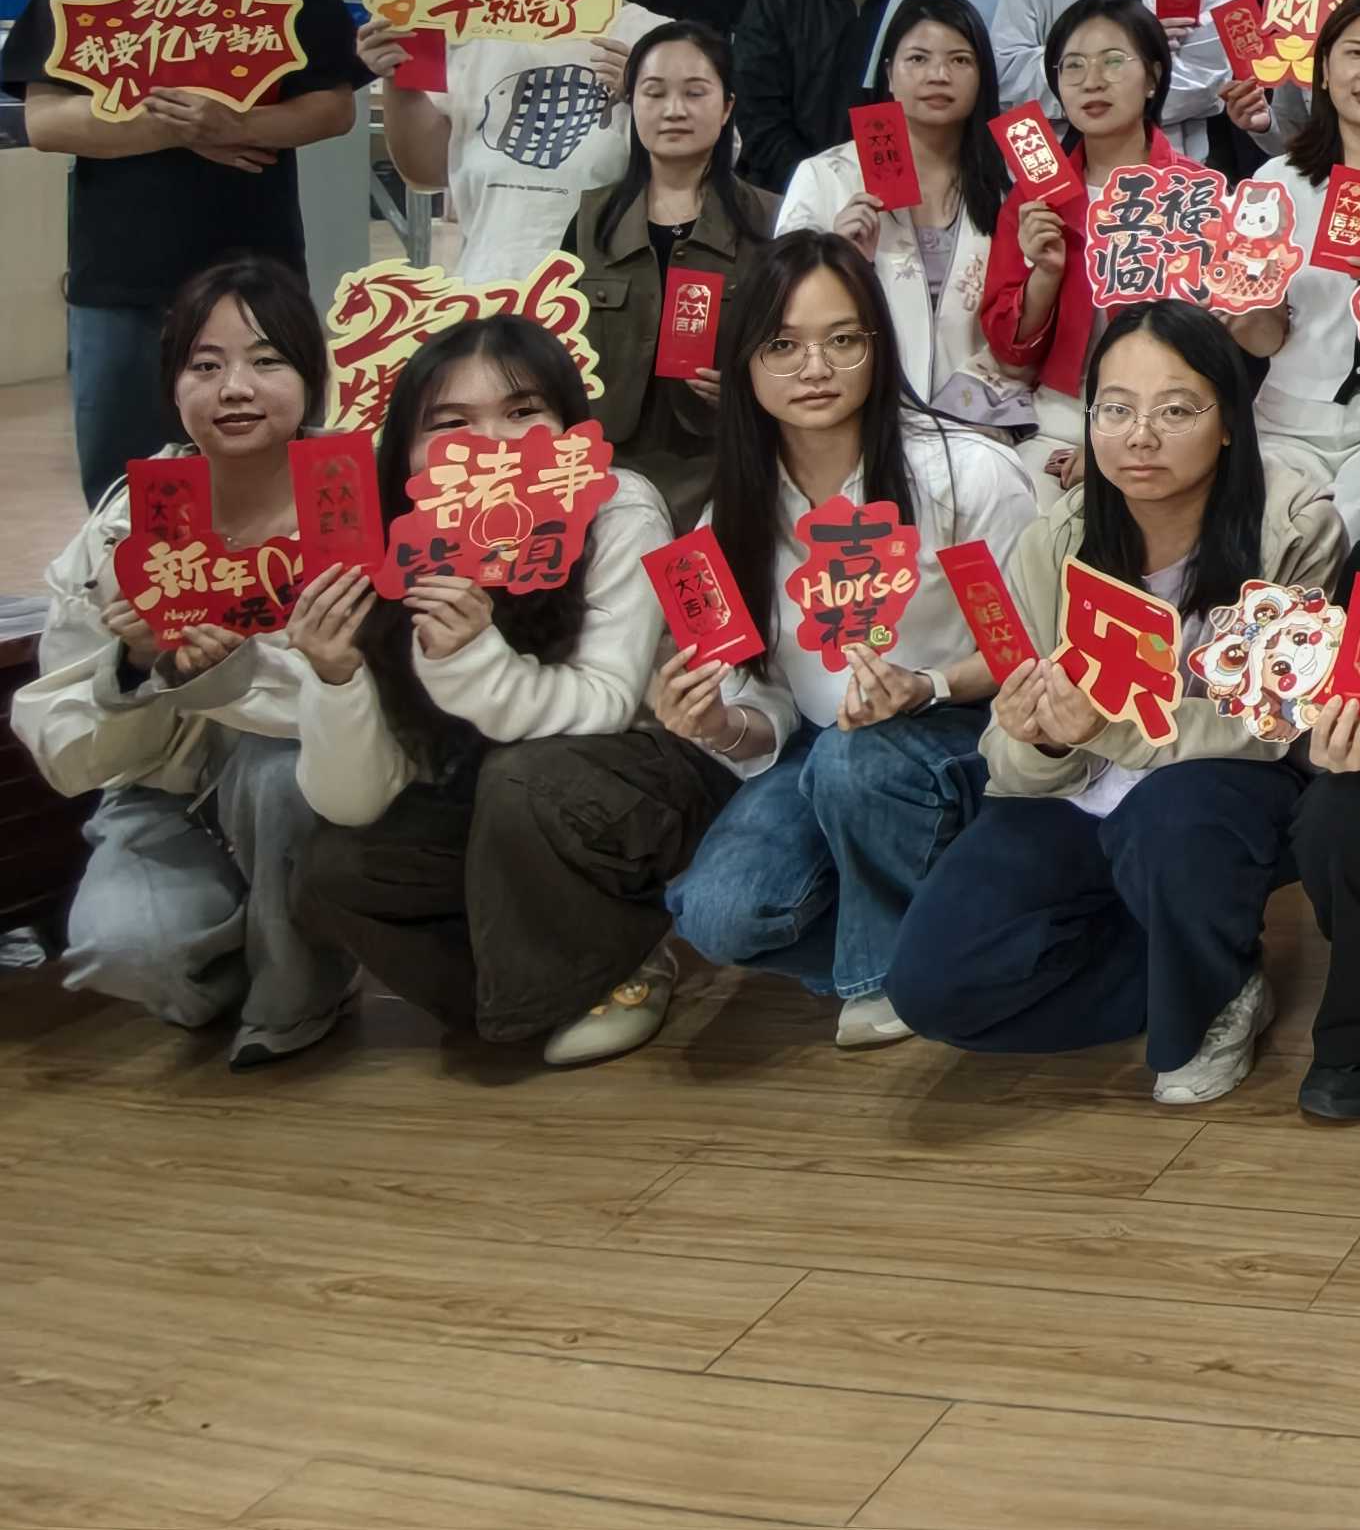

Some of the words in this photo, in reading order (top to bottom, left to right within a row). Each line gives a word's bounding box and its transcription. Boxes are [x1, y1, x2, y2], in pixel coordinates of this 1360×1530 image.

[74, 22, 285, 76] 我要亿马当先
[1097, 173, 1222, 237] 五福
[1095, 231, 1214, 302] 临门
[134, 541, 257, 611] 新年
[800, 567, 917, 610] Horse
[162, 608, 209, 623] Happy
[1054, 561, 1177, 743] 乐
